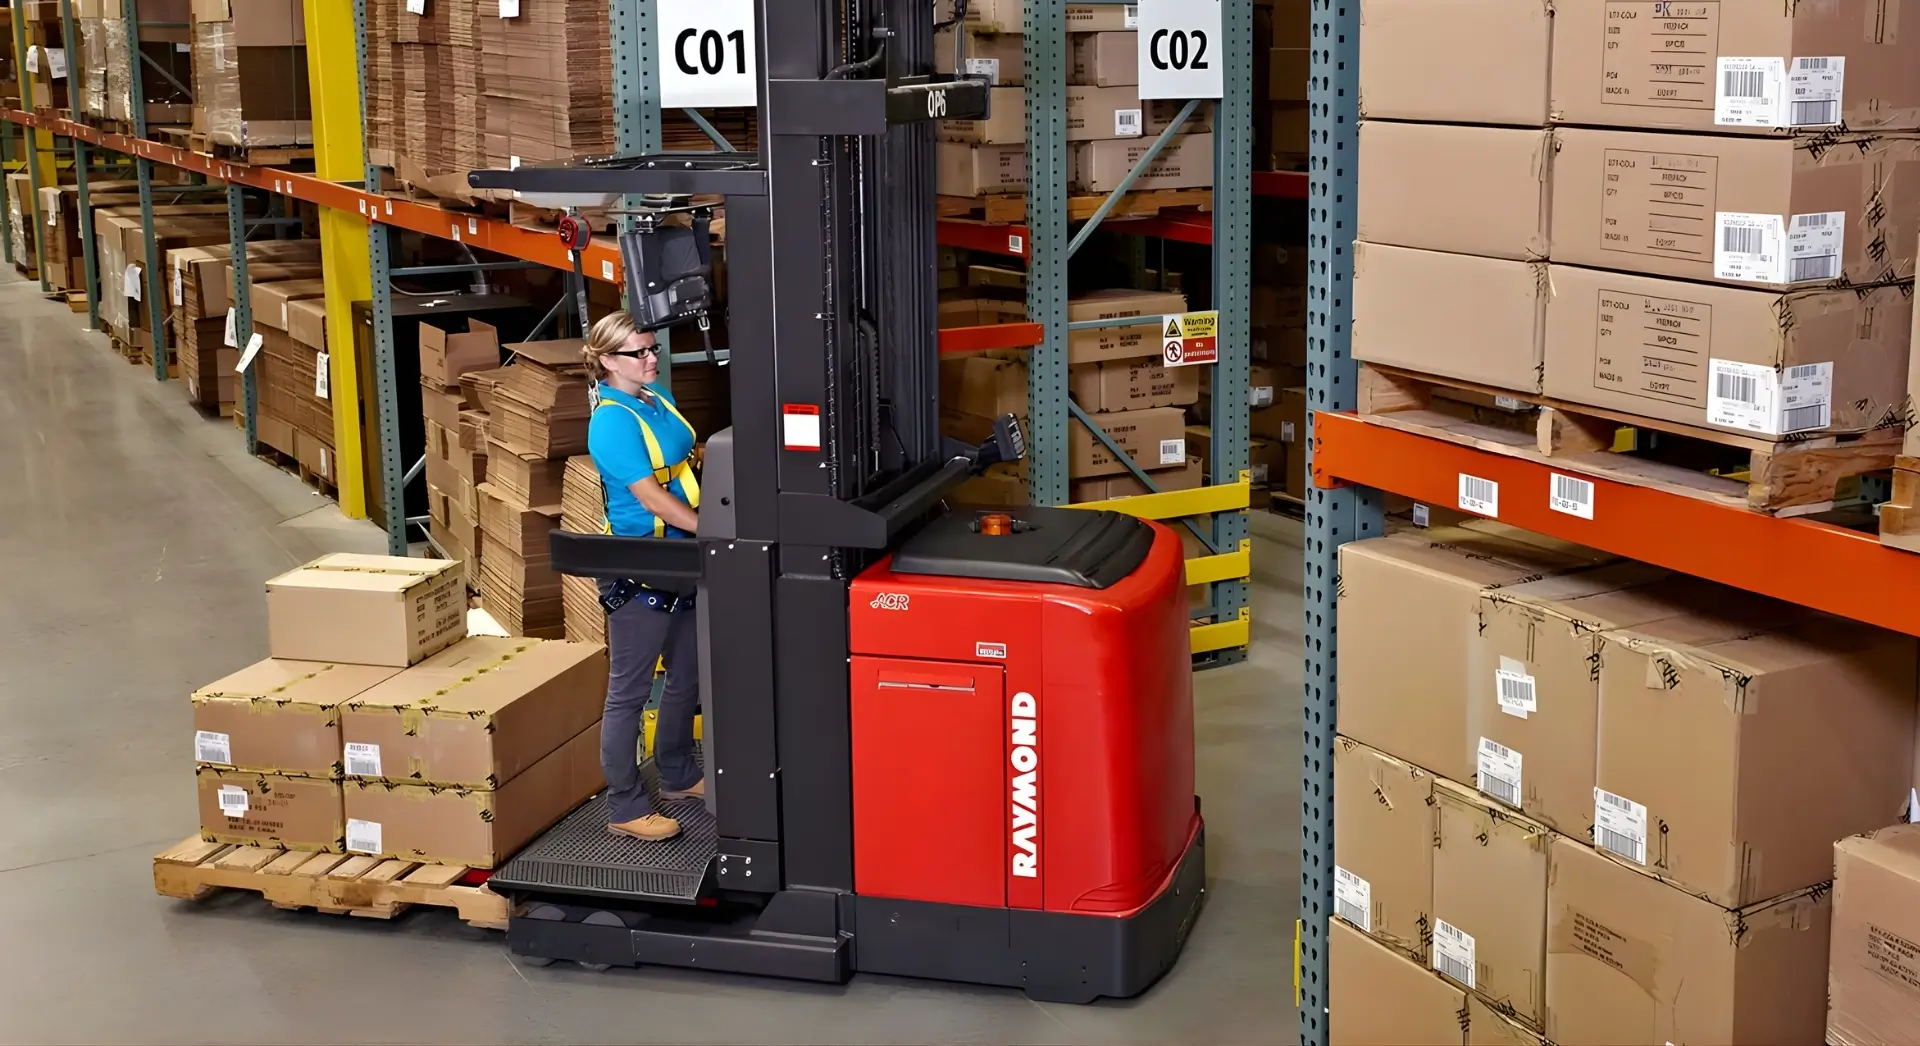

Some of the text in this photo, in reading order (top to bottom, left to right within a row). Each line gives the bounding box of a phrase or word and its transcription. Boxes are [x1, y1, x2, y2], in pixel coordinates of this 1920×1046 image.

[674, 28, 746, 75] C01
[1150, 28, 1209, 71] C02
[870, 592, 910, 611] ACR
[1010, 691, 1038, 878] RAYMOND
